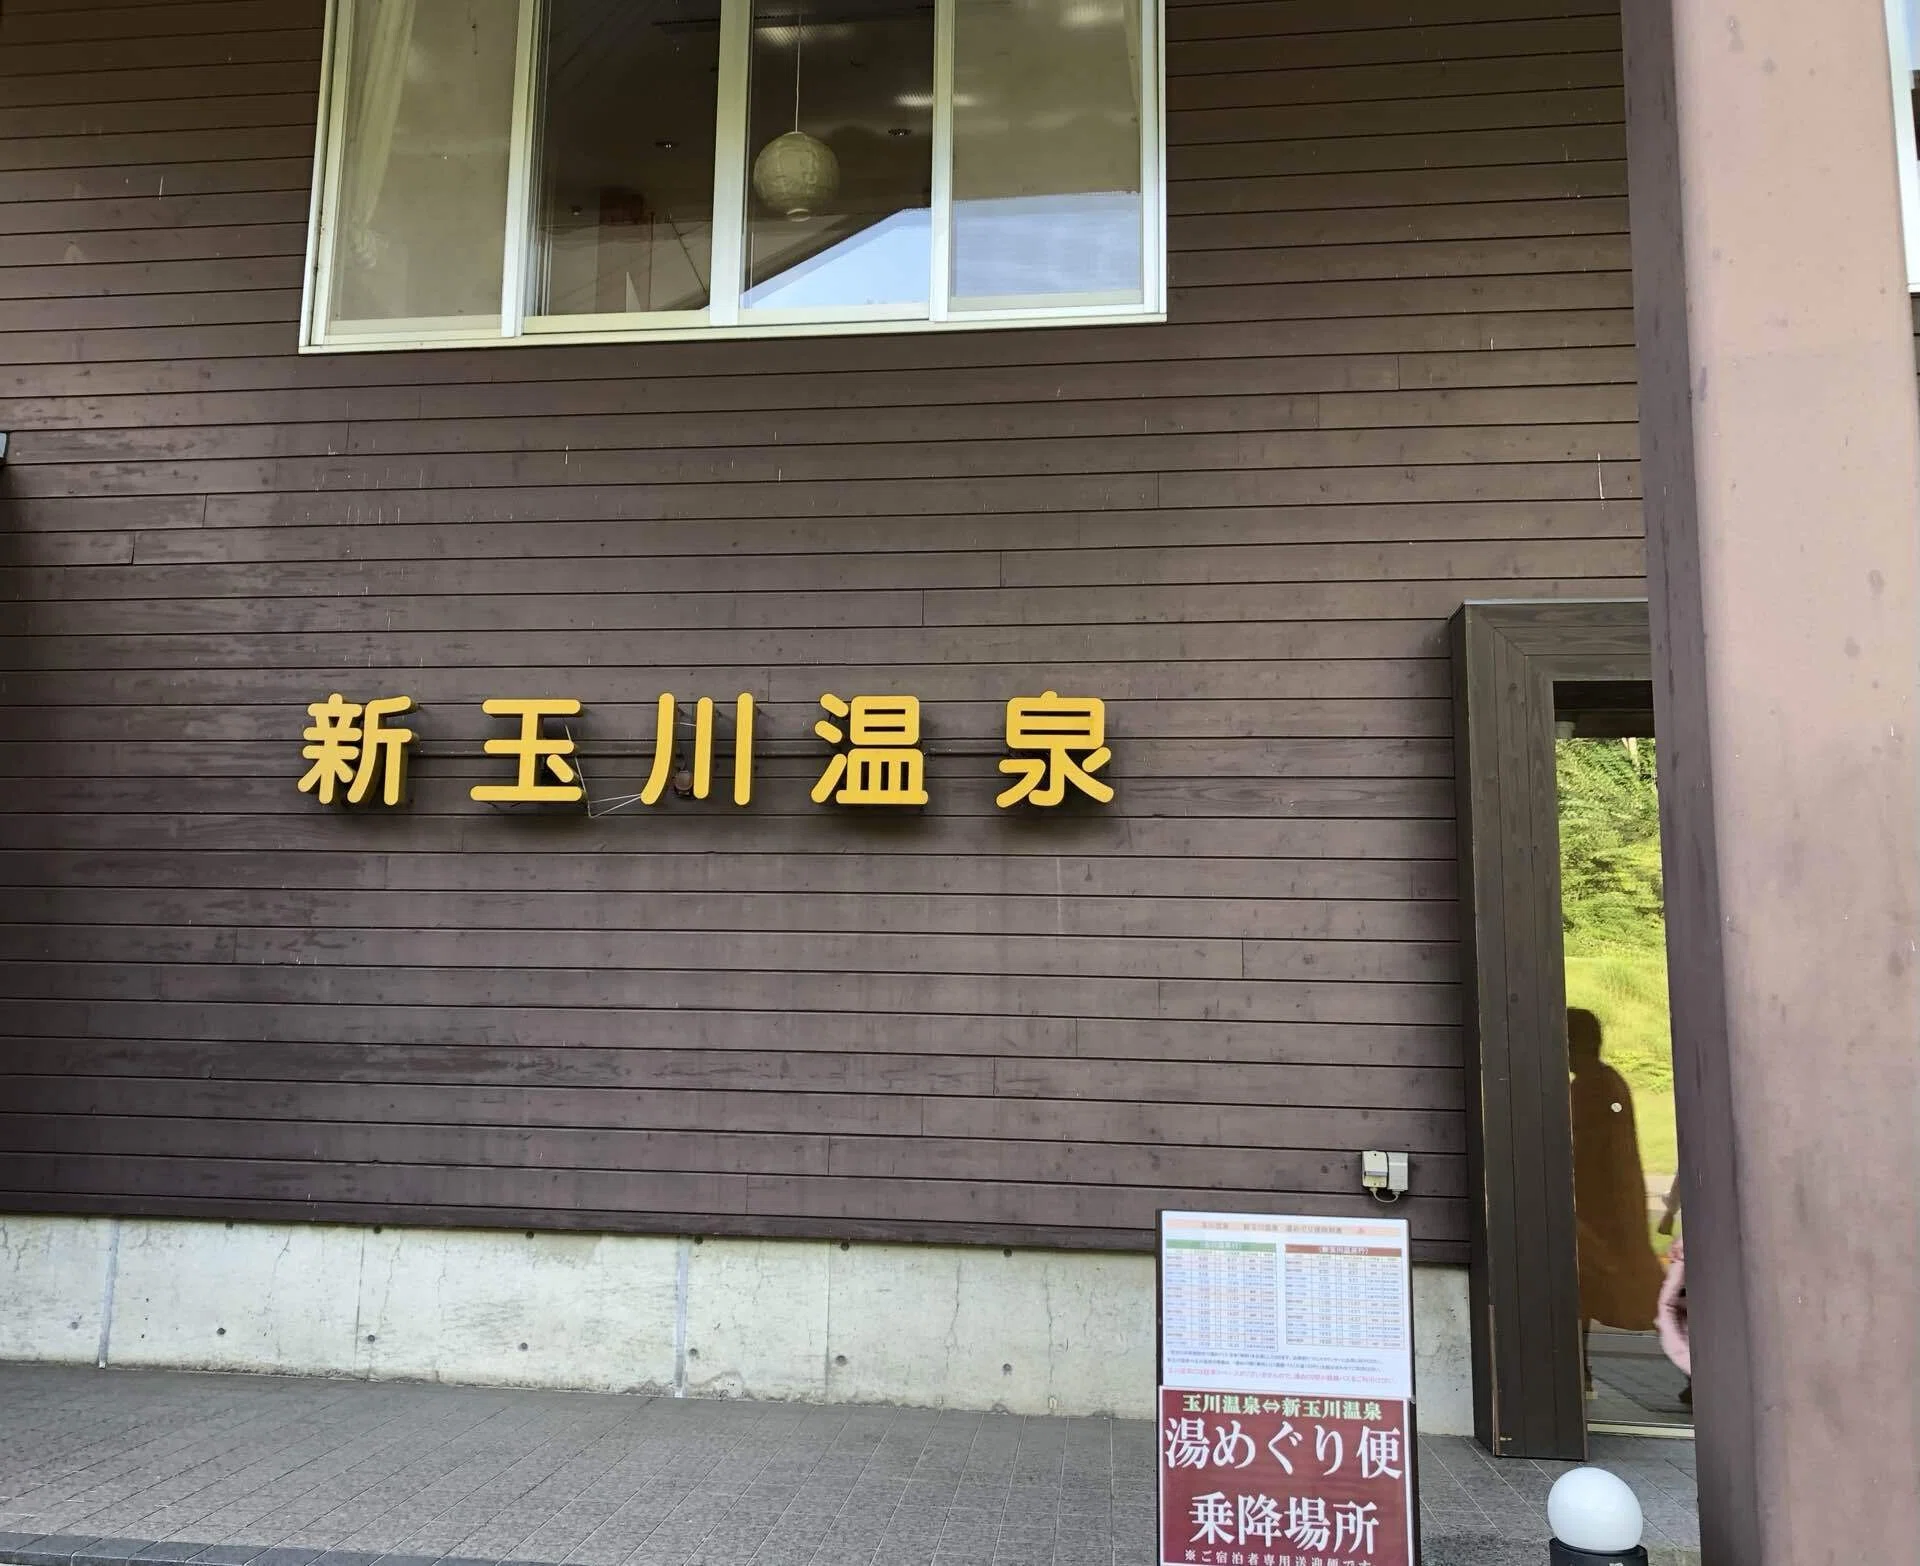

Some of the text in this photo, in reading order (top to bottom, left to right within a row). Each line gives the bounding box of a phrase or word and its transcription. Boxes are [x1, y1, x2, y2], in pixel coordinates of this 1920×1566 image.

[298, 691, 1115, 809] 新玉川温泉
[1165, 1417, 1402, 1479] 湯めぐり便
[1188, 1491, 1379, 1555] 乗降場所
